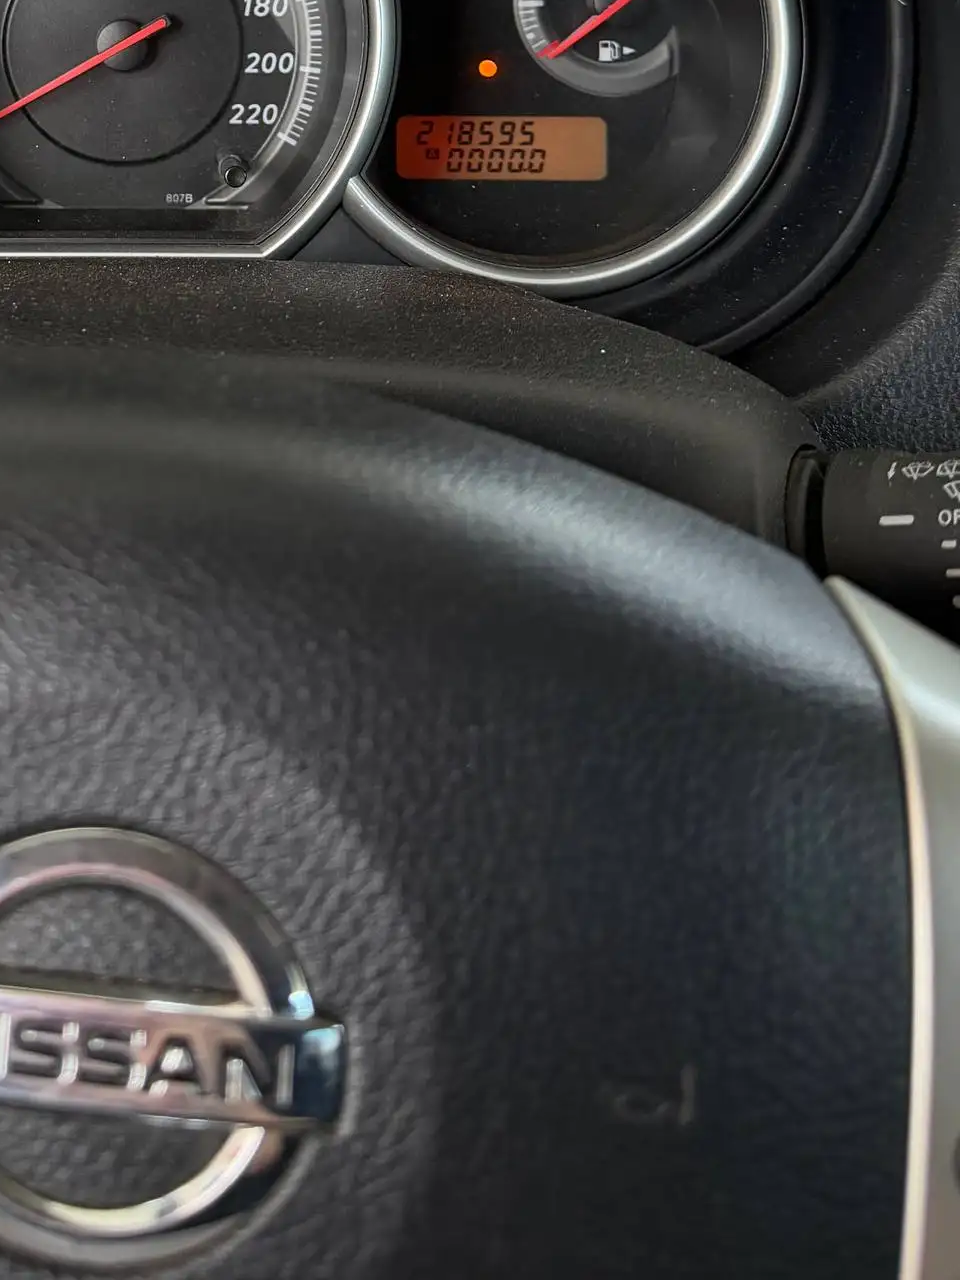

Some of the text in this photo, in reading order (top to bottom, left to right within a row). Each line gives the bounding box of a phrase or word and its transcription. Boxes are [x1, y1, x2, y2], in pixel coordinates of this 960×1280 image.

[244, 52, 295, 74] 200
[228, 103, 278, 125] 220
[416, 120, 536, 146] 218595
